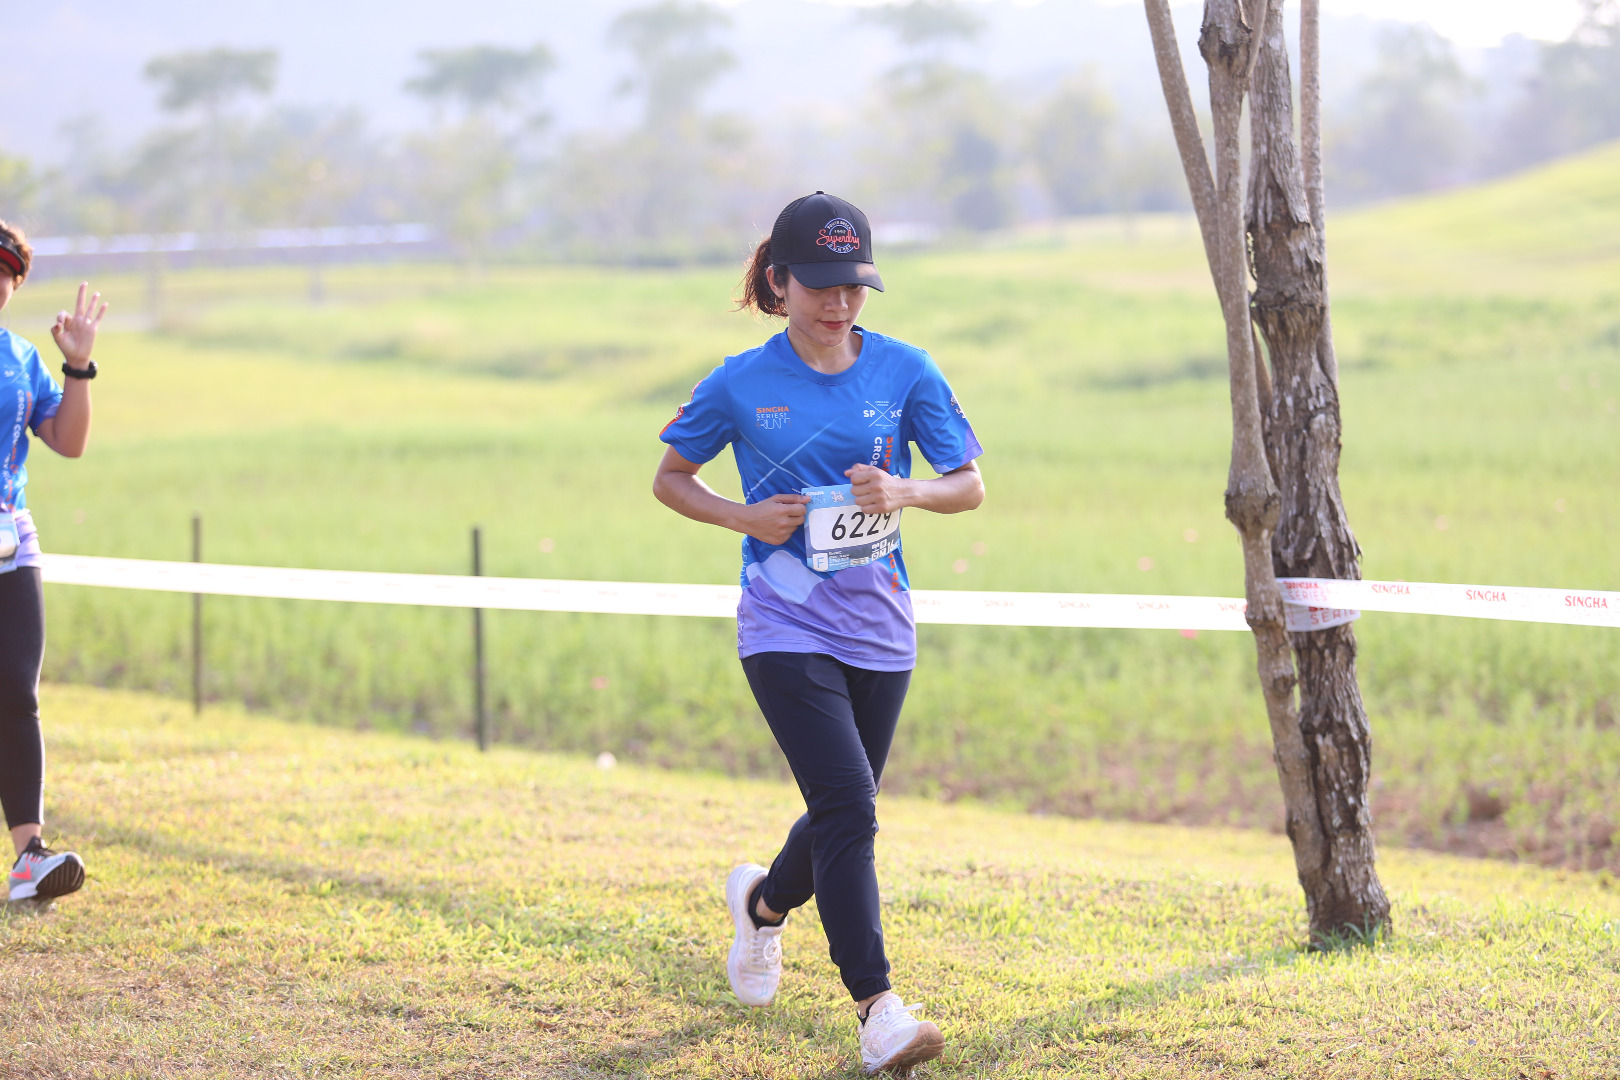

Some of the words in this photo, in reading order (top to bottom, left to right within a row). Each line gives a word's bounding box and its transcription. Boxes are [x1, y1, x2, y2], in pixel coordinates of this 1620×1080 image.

[816, 229, 860, 250] Superdry
[863, 410, 876, 418] SP
[870, 436, 883, 466] CROS
[881, 436, 894, 471] SING
[831, 511, 893, 541] 6229
[817, 557, 824, 569] F
[1371, 584, 1411, 596] SINGHA
[1465, 589, 1507, 602] SINGHA
[1564, 595, 1609, 609] SINGHA
